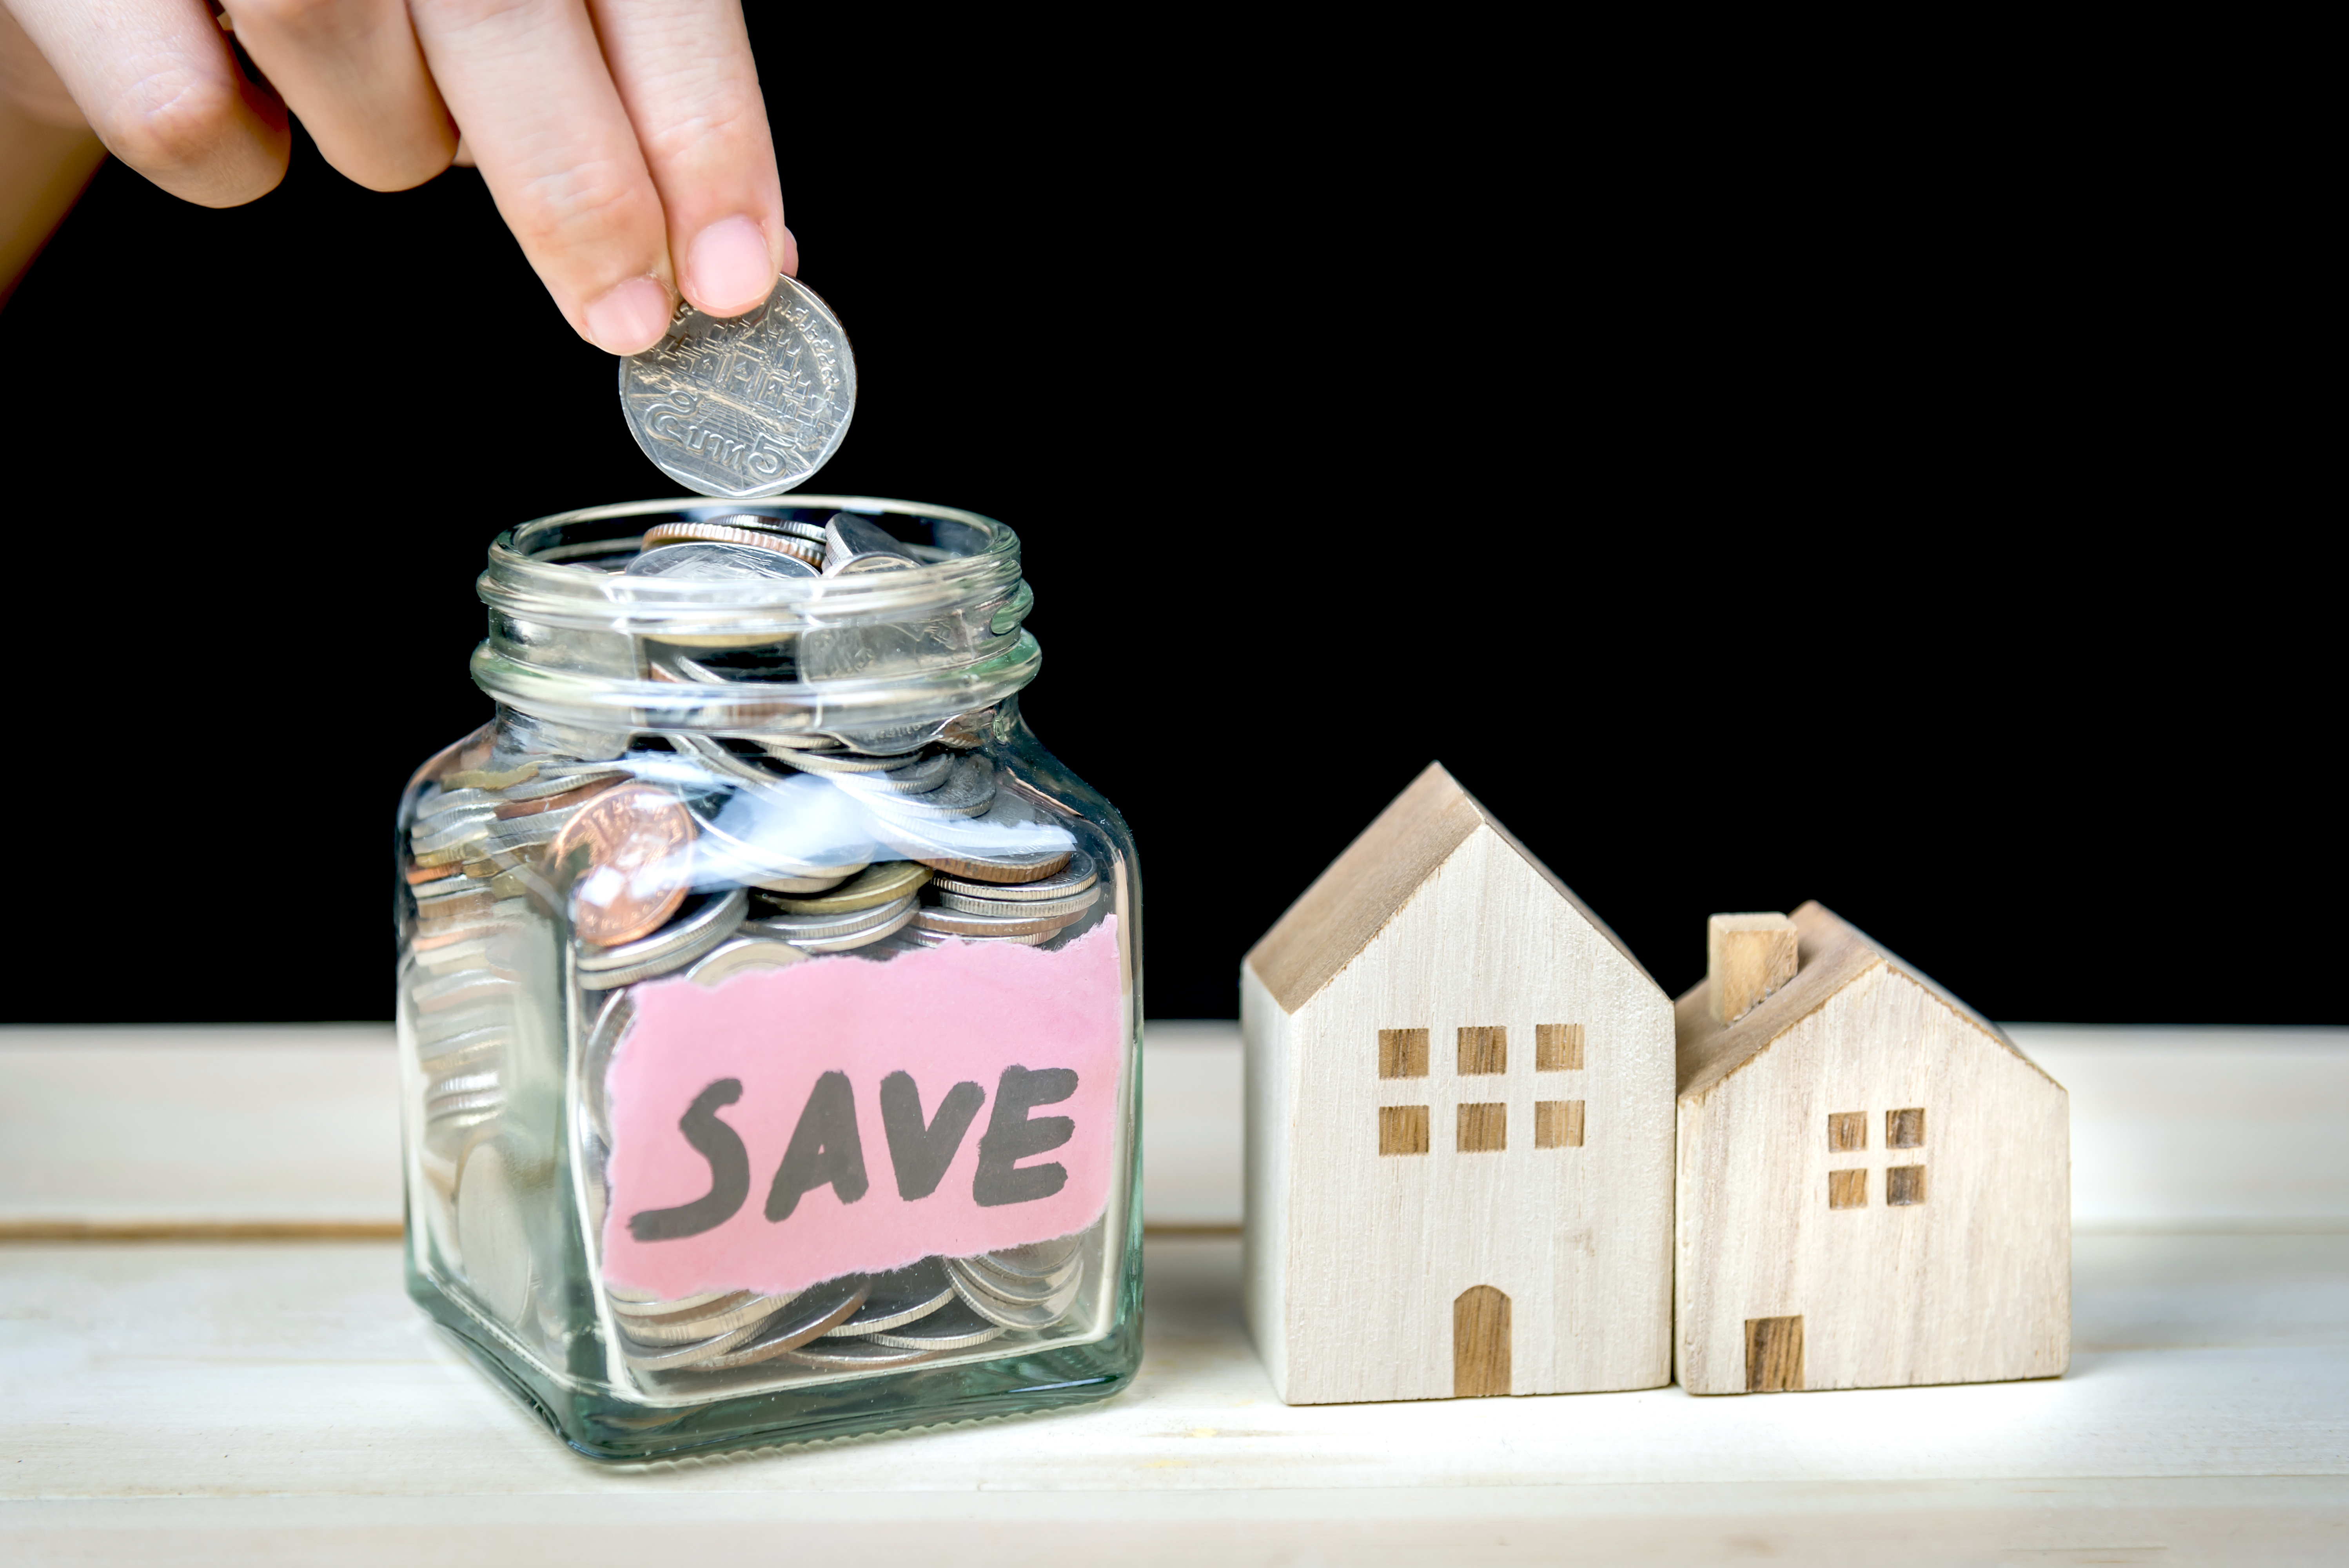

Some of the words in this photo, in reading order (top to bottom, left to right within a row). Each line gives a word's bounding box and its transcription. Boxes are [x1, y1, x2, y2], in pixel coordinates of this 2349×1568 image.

[686, 425, 745, 470] บาท
[748, 432, 796, 480] 5
[627, 1065, 1080, 1242] SAVE
